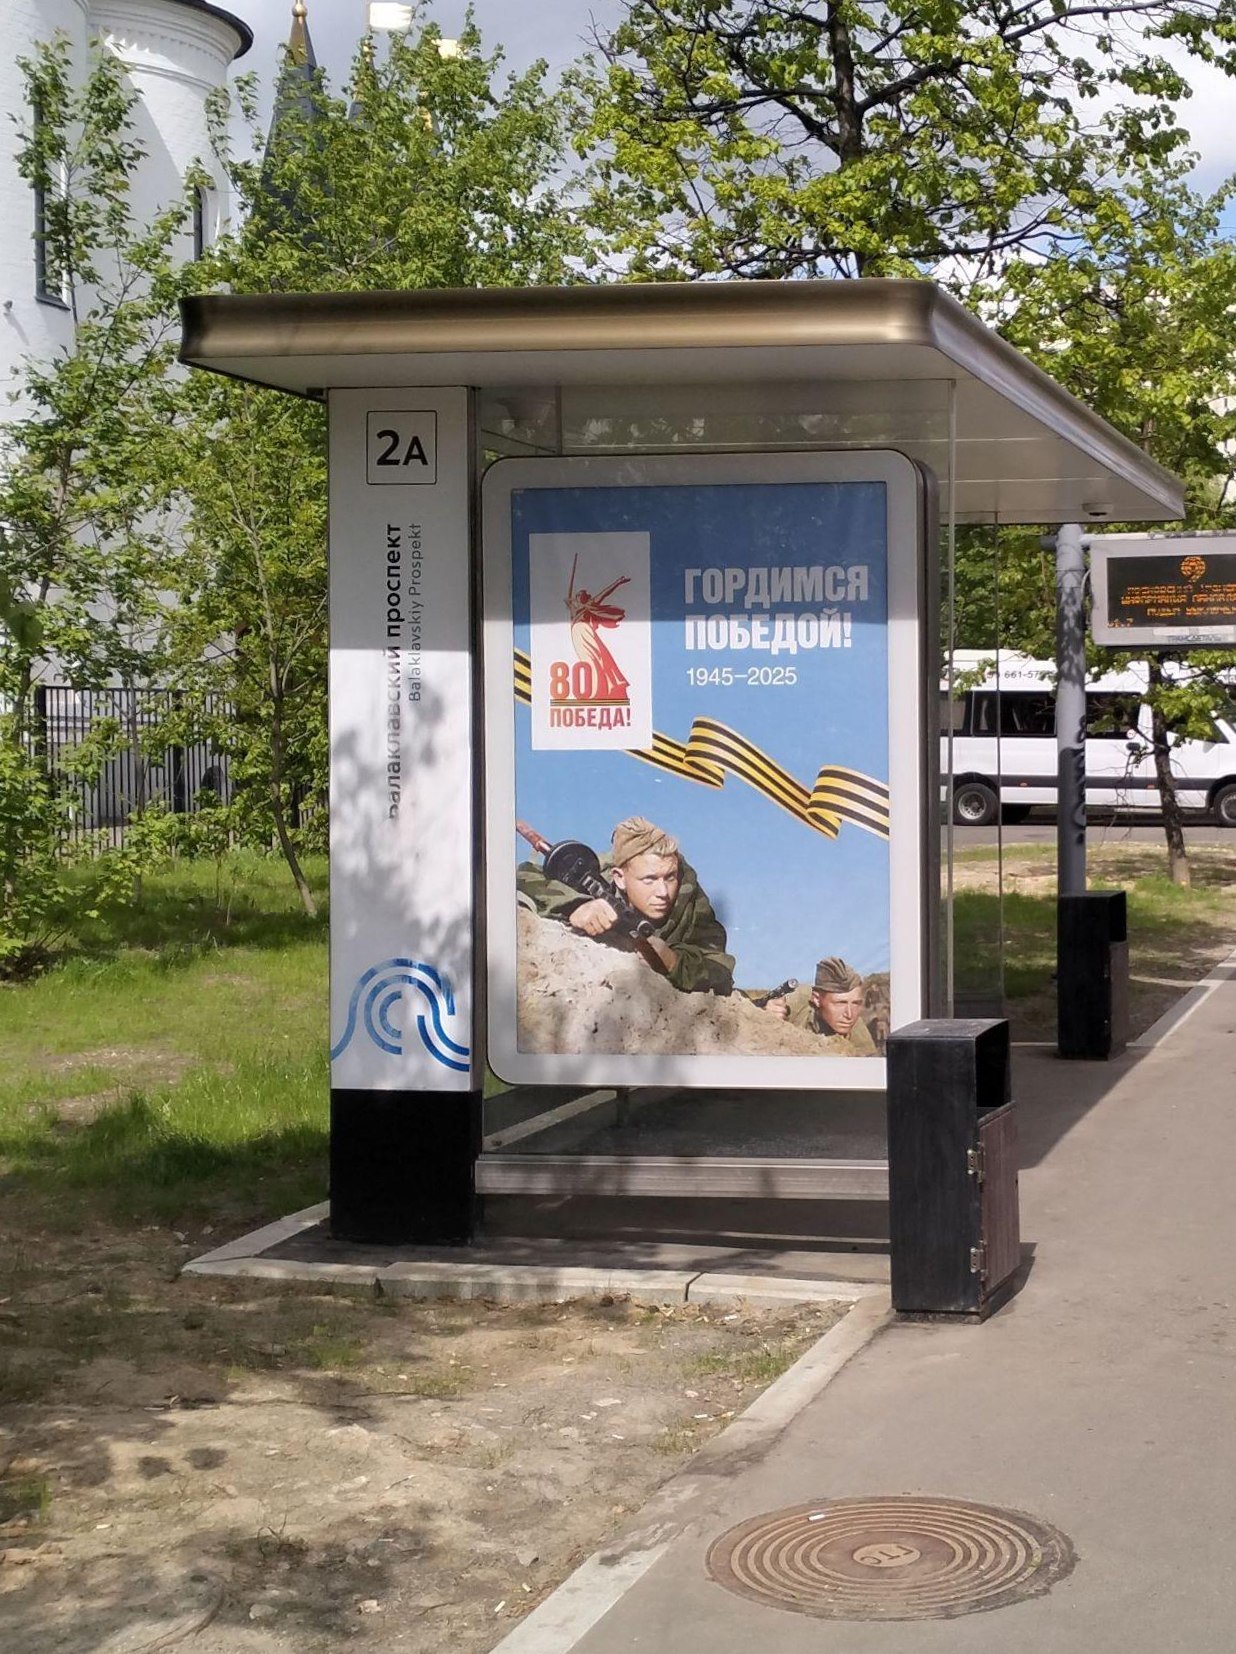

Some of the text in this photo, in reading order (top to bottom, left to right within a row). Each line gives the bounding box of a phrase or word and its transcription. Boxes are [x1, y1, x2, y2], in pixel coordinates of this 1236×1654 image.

[386, 523, 406, 638] проспект
[684, 565, 868, 608] ГОРДИМСЯ
[408, 523, 424, 702] Balaklavskiy Prospekt
[685, 608, 853, 654] ПОБЕДОЙ!
[549, 661, 595, 700] 80
[549, 707, 632, 730] ПОБЕДА!
